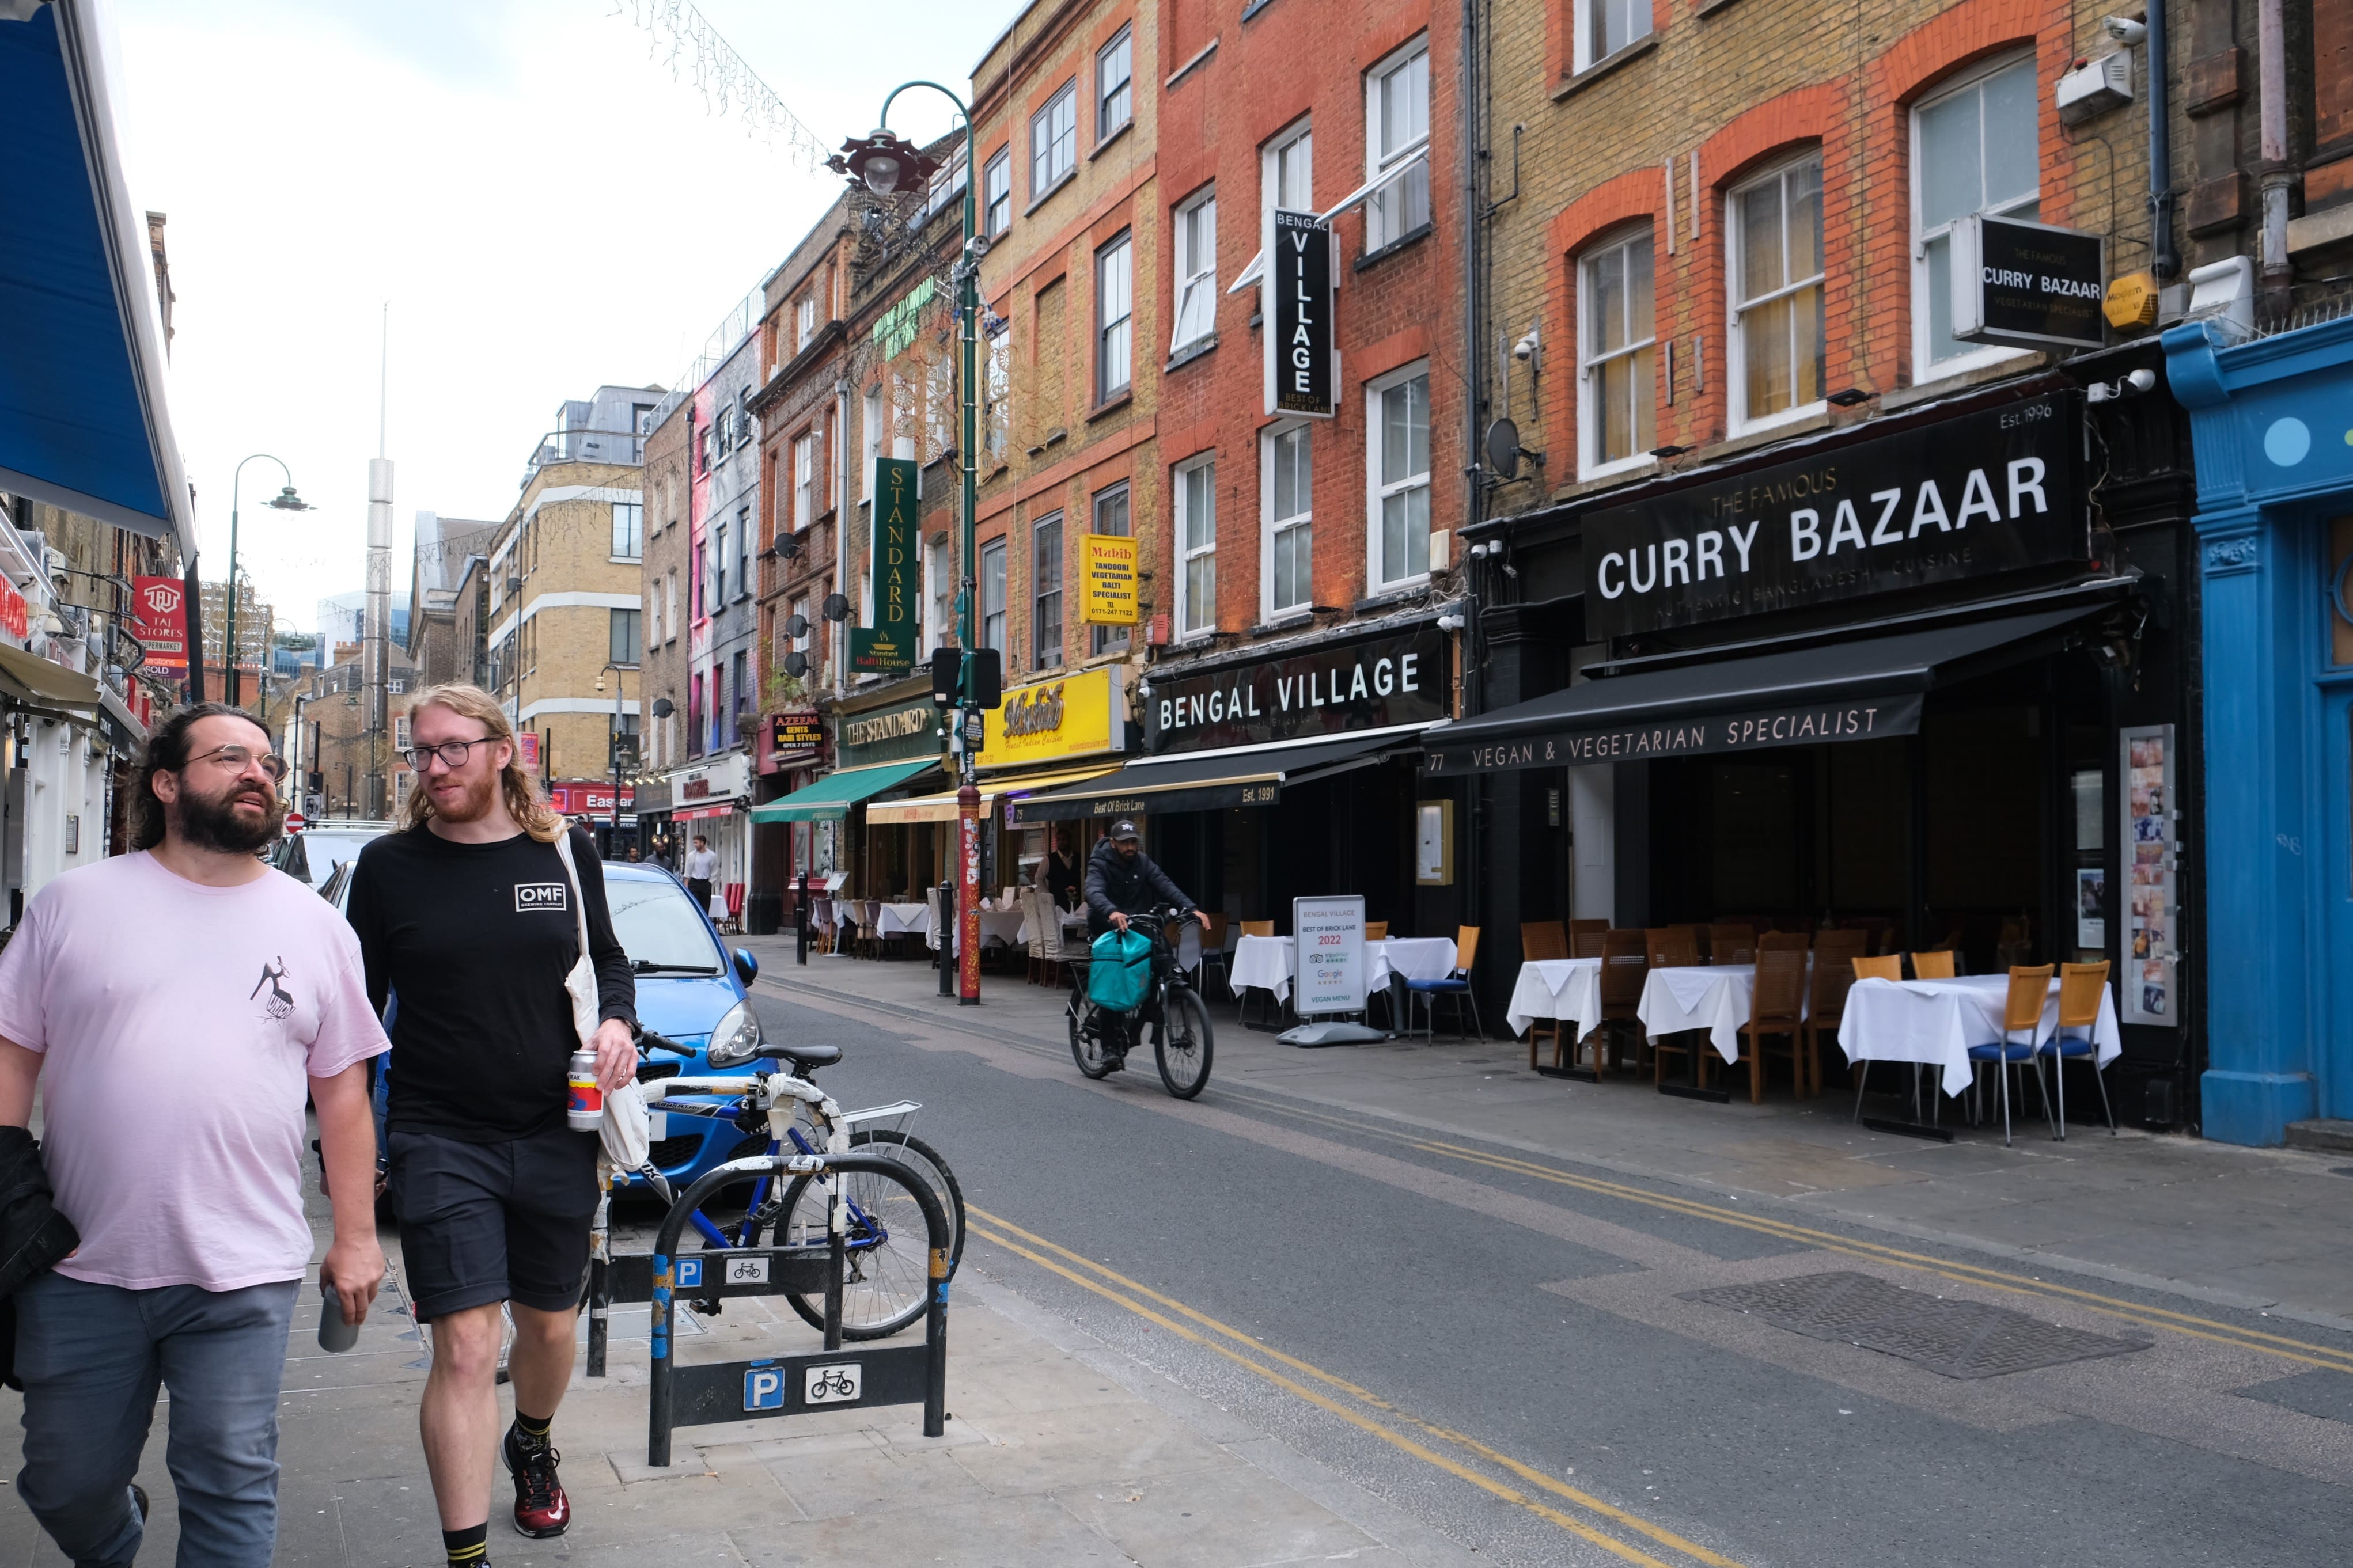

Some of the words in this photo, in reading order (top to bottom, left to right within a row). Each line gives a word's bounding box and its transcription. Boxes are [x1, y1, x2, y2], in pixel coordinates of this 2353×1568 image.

[1277, 214, 1327, 231] BENGAL
[1983, 266, 2033, 290] CURRY
[2041, 275, 2101, 299] BAZAAR
[1292, 231, 1312, 392] VILLAGE
[1286, 393, 1305, 403] BEST
[1308, 396, 1320, 404] OF
[1279, 401, 1307, 411] BRICK
[2023, 404, 2052, 424] 1996
[1711, 493, 1744, 518] THE
[1749, 466, 1837, 511] FAMOUS
[1598, 521, 1760, 599] CURRY
[1791, 457, 2048, 563] BAZAAR
[888, 467, 904, 622] STANDARD
[1095, 562, 1129, 571] TANDOORI
[1092, 571, 1132, 580] VEGETARIAN
[1093, 590, 1131, 599] SPECIALIST
[153, 617, 171, 628] TAJ
[139, 627, 183, 637] STORES
[145, 666, 169, 674] SOLD
[1102, 670, 1108, 679] 73
[1161, 685, 1260, 730] BENGAL
[1278, 653, 1419, 711] VILLAGE
[775, 716, 820, 726] AZEEM
[846, 722, 864, 746] THE
[866, 708, 925, 742] STANDARD
[1042, 735, 1063, 745] Cuisine
[1472, 745, 1533, 768] VEGAN
[1545, 742, 1555, 760] &
[1570, 726, 1704, 758] VEGETARIAN
[1727, 708, 1877, 743] SPECIALIST
[1430, 754, 1443, 770] 77
[586, 795, 634, 807] Easer
[1242, 788, 1256, 803] Est.
[1257, 787, 1275, 802] 1991
[1094, 803, 1106, 814] Best
[1107, 801, 1115, 813] Of
[1115, 800, 1130, 811] Brick
[1131, 799, 1145, 811] Lane
[1016, 809, 1024, 820] 75
[520, 888, 562, 902] OMF
[1318, 935, 1341, 945] 2022
[1318, 970, 1342, 979] Google
[267, 993, 296, 1019] UNION
[655, 1102, 700, 1111] TRAKATAK
[679, 1262, 696, 1284] P
[753, 1373, 778, 1406] P
